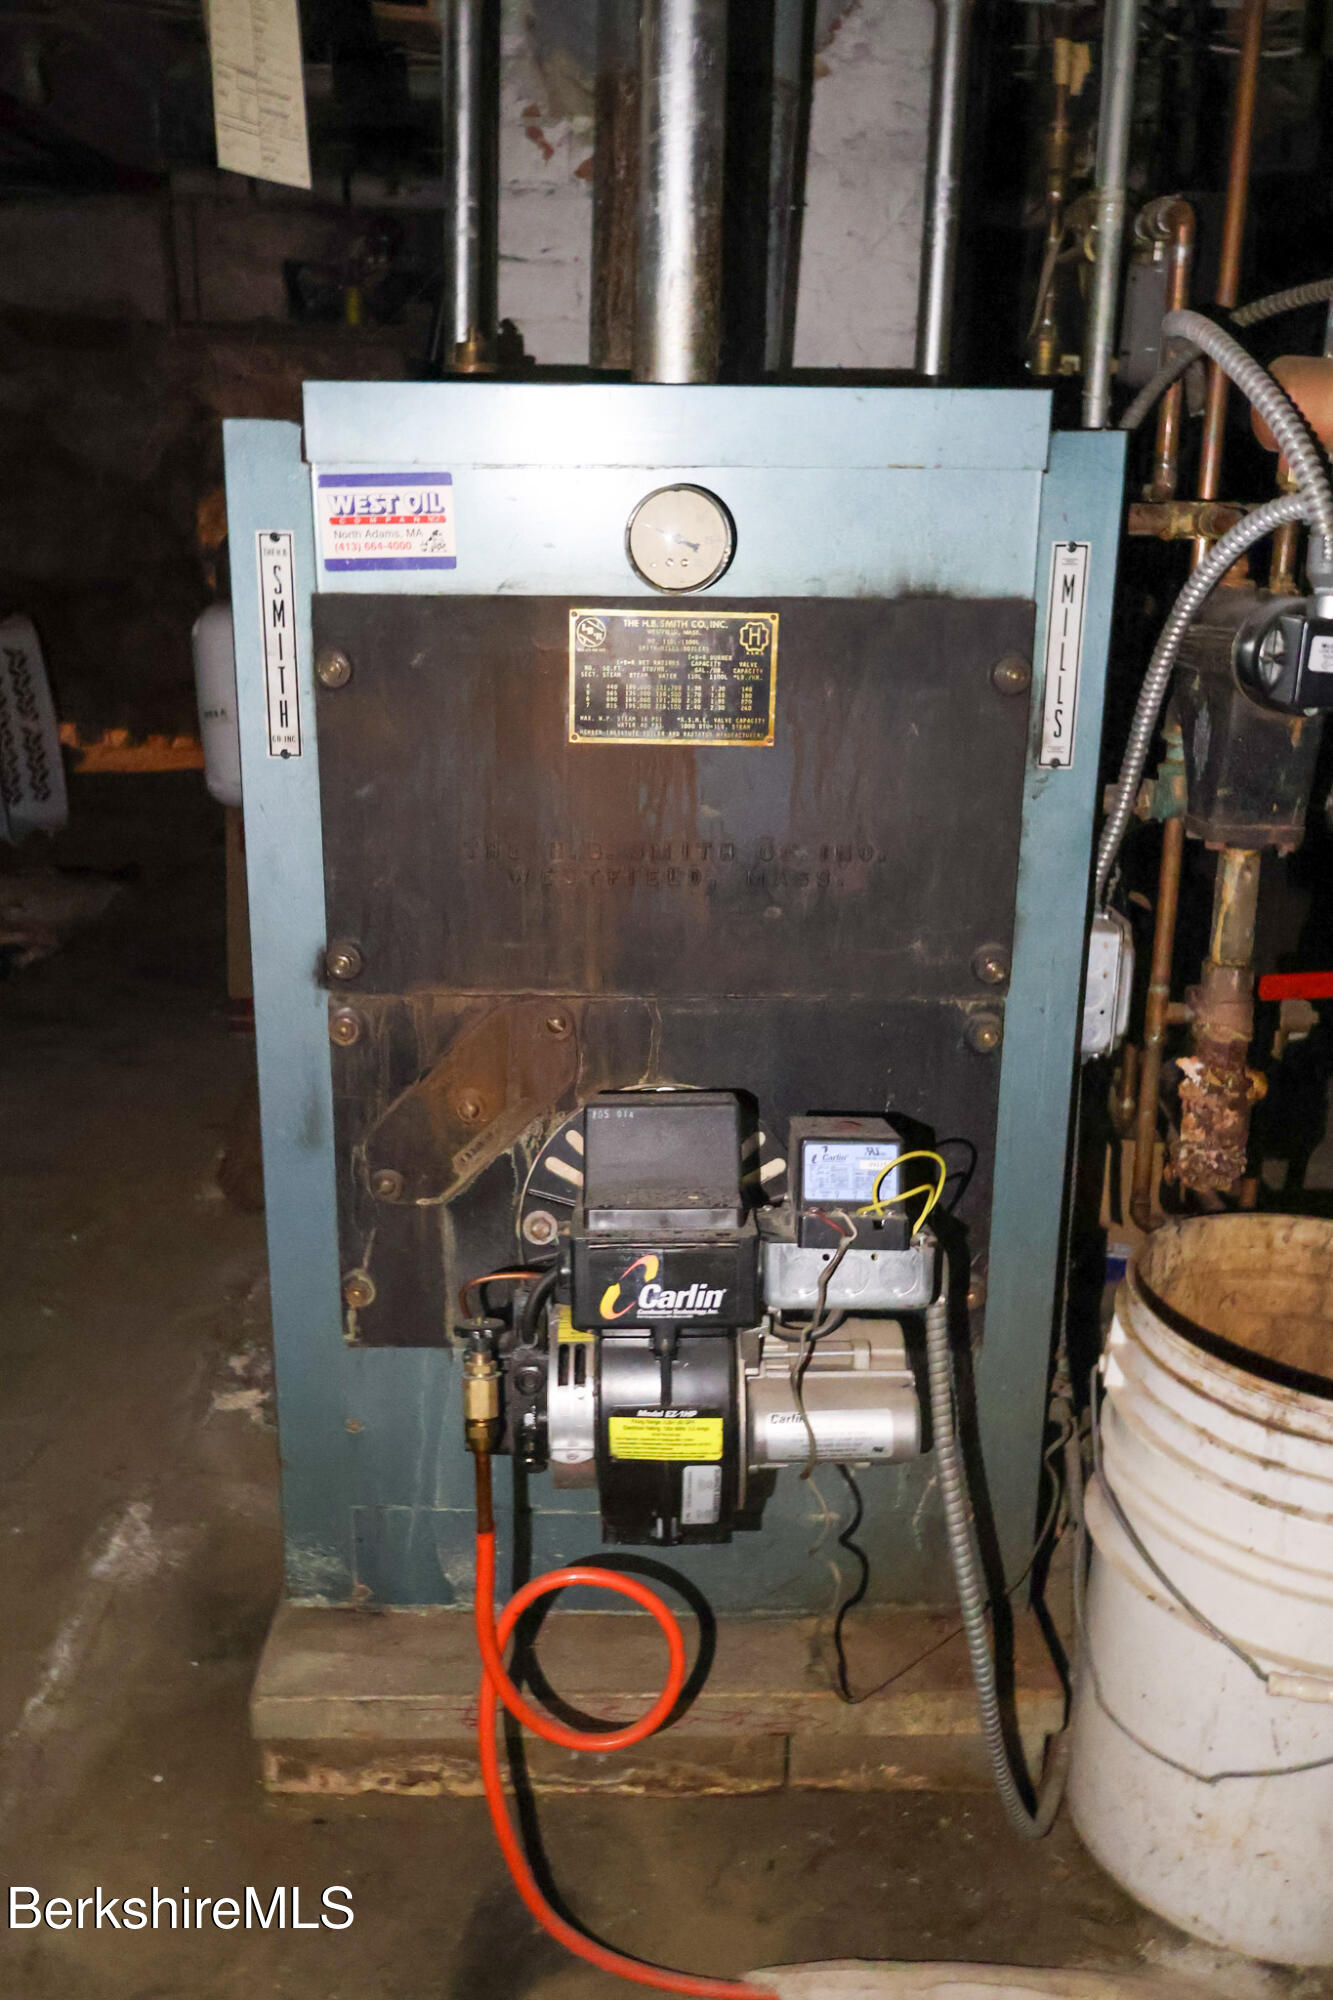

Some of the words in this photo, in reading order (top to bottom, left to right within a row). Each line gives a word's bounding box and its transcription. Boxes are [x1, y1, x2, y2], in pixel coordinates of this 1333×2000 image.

[327, 494, 400, 516] WEST
[405, 492, 445, 515] OIL
[338, 515, 442, 524] COMPANY
[334, 530, 361, 539] North
[406, 528, 424, 538] MA
[334, 542, 361, 552] (413)
[624, 619, 640, 628] THE
[660, 620, 688, 629] SMITH
[272, 564, 290, 729] SMITH
[1053, 574, 1076, 738] MILLS
[638, 1283, 727, 1310] Carlin
[636, 1409, 664, 1418] Model
